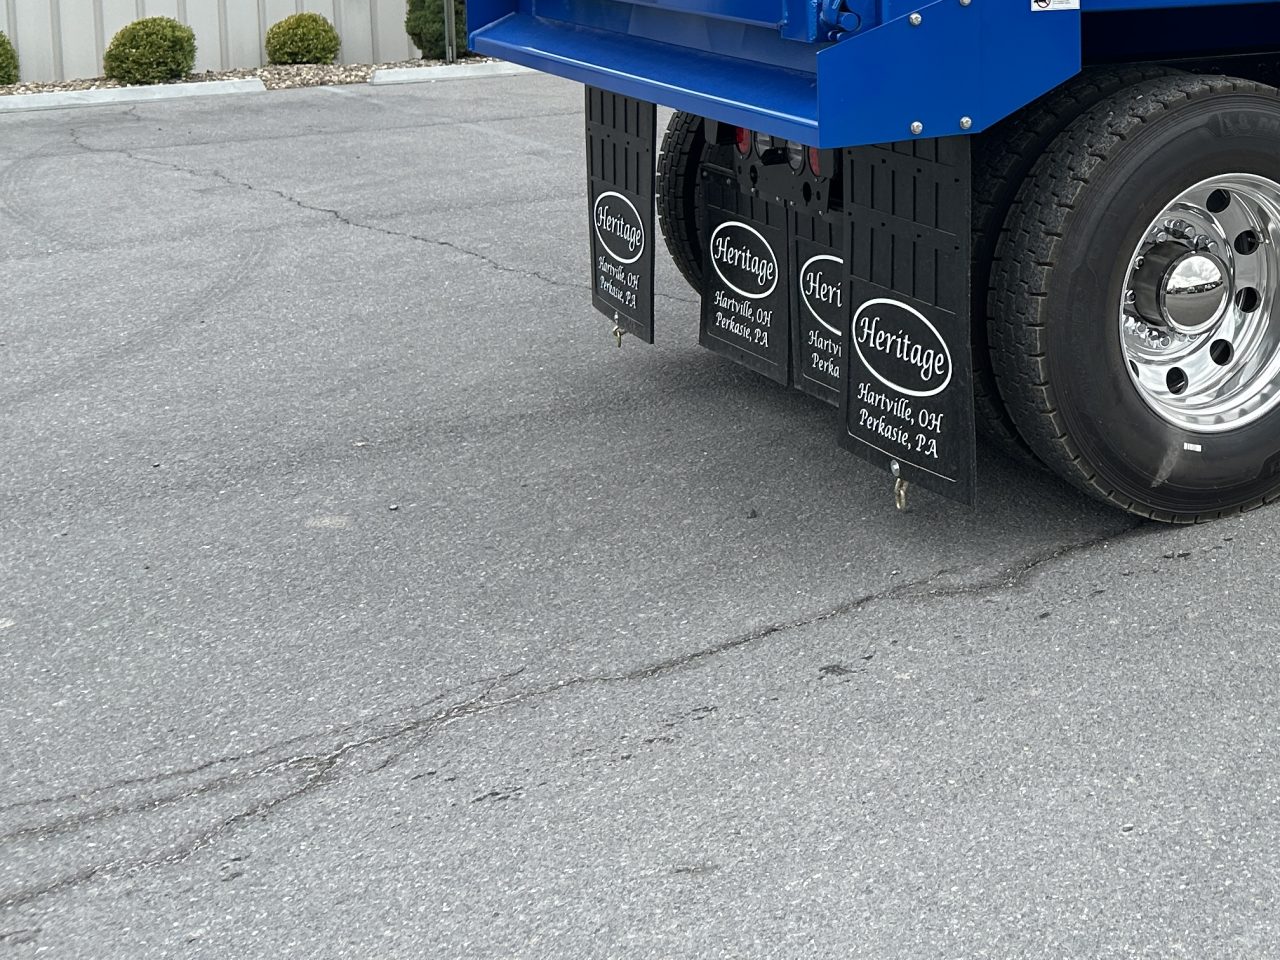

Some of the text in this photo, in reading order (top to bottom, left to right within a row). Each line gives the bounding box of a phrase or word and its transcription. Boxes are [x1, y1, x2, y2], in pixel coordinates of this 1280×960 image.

[597, 205, 641, 251] Heritage
[598, 256, 640, 290] Hartville, OH
[714, 236, 774, 285] Heritage
[625, 291, 637, 309] PA
[805, 271, 843, 307] Heri
[714, 291, 772, 327] Hartville, OH
[715, 312, 769, 347] Perkasie, PA
[808, 330, 842, 358] Hartvi
[811, 353, 840, 378] Perka
[858, 316, 945, 381] Heritage
[857, 382, 943, 433] Hartville, OH
[859, 408, 939, 458] Perkasie, PA
